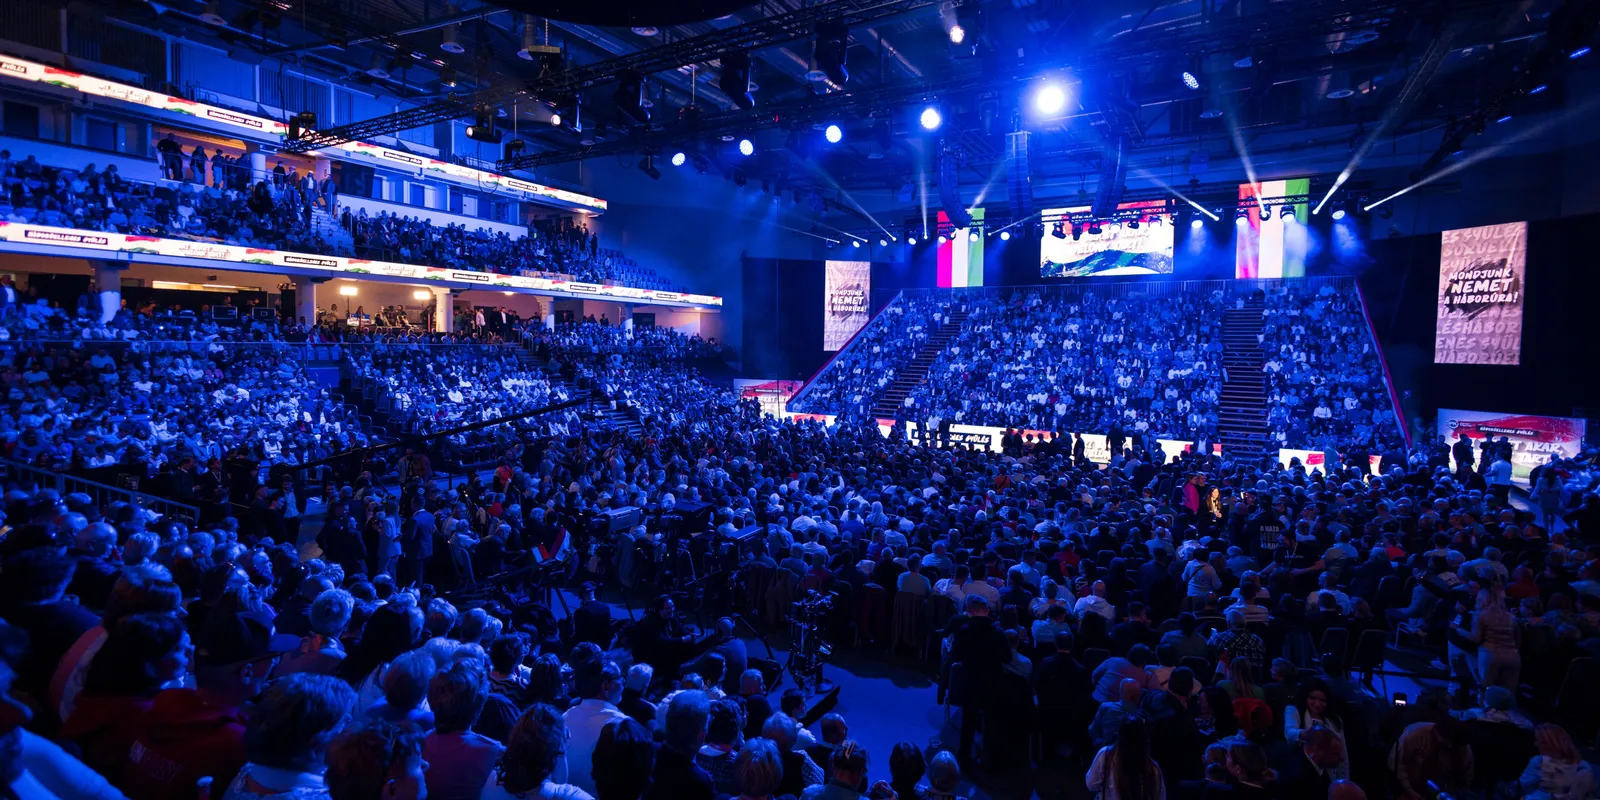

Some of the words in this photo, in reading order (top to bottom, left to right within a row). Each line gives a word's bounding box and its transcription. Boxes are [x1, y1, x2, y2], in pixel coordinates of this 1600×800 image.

[1448, 268, 1512, 281] MONDJUNK
[1451, 277, 1514, 294] NEMET
[831, 296, 865, 305] NEMET
[1444, 295, 1450, 304] A
[1453, 291, 1518, 304] HÁBORÚRA!
[1525, 441, 1563, 455] AKAR,
[1519, 452, 1551, 465] TART
